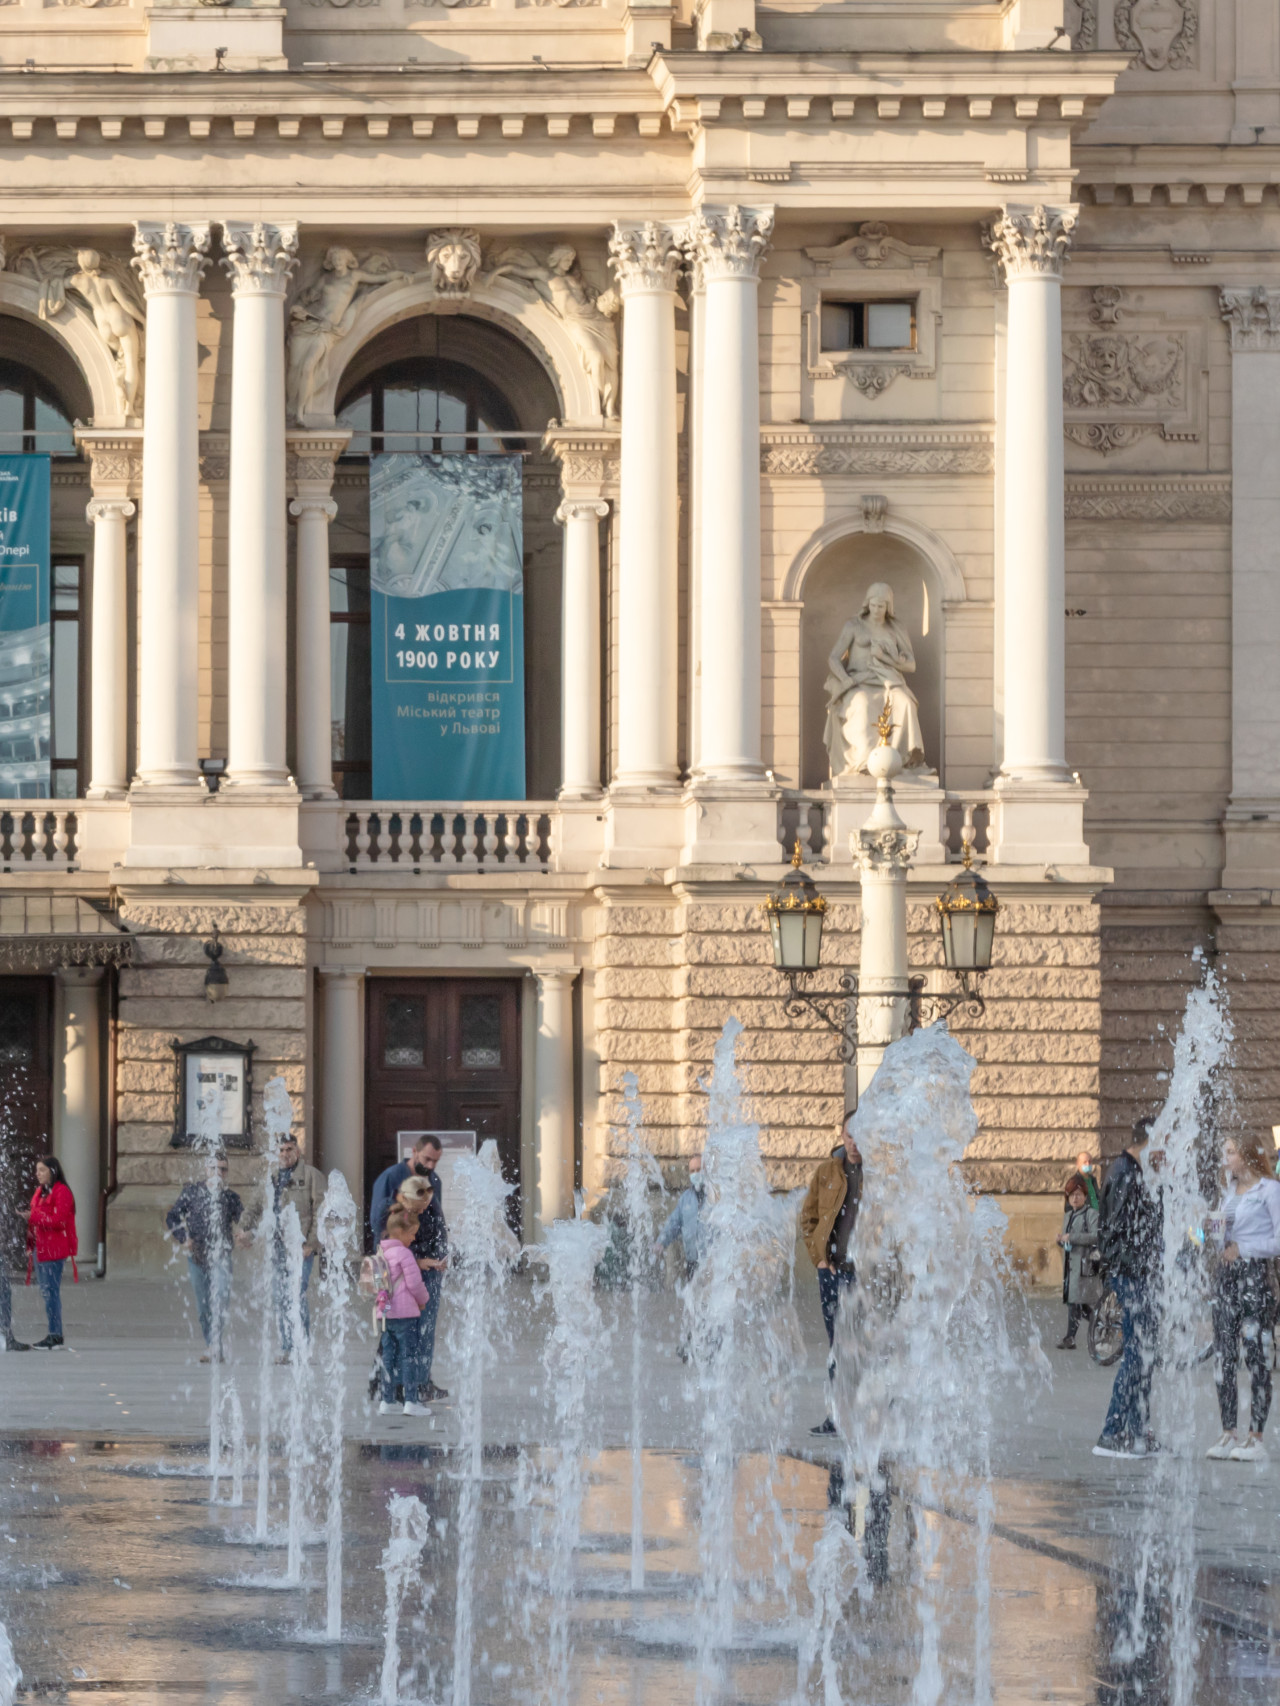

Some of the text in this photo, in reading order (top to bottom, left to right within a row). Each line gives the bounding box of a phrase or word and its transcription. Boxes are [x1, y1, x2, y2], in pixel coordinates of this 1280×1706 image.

[394, 623, 500, 642] 4 ЖОВТНЯ
[396, 650, 500, 669] 1900 РОКУ
[427, 690, 500, 705] відкрився
[397, 704, 501, 720] Міський театр
[440, 721, 500, 736] у Львові
